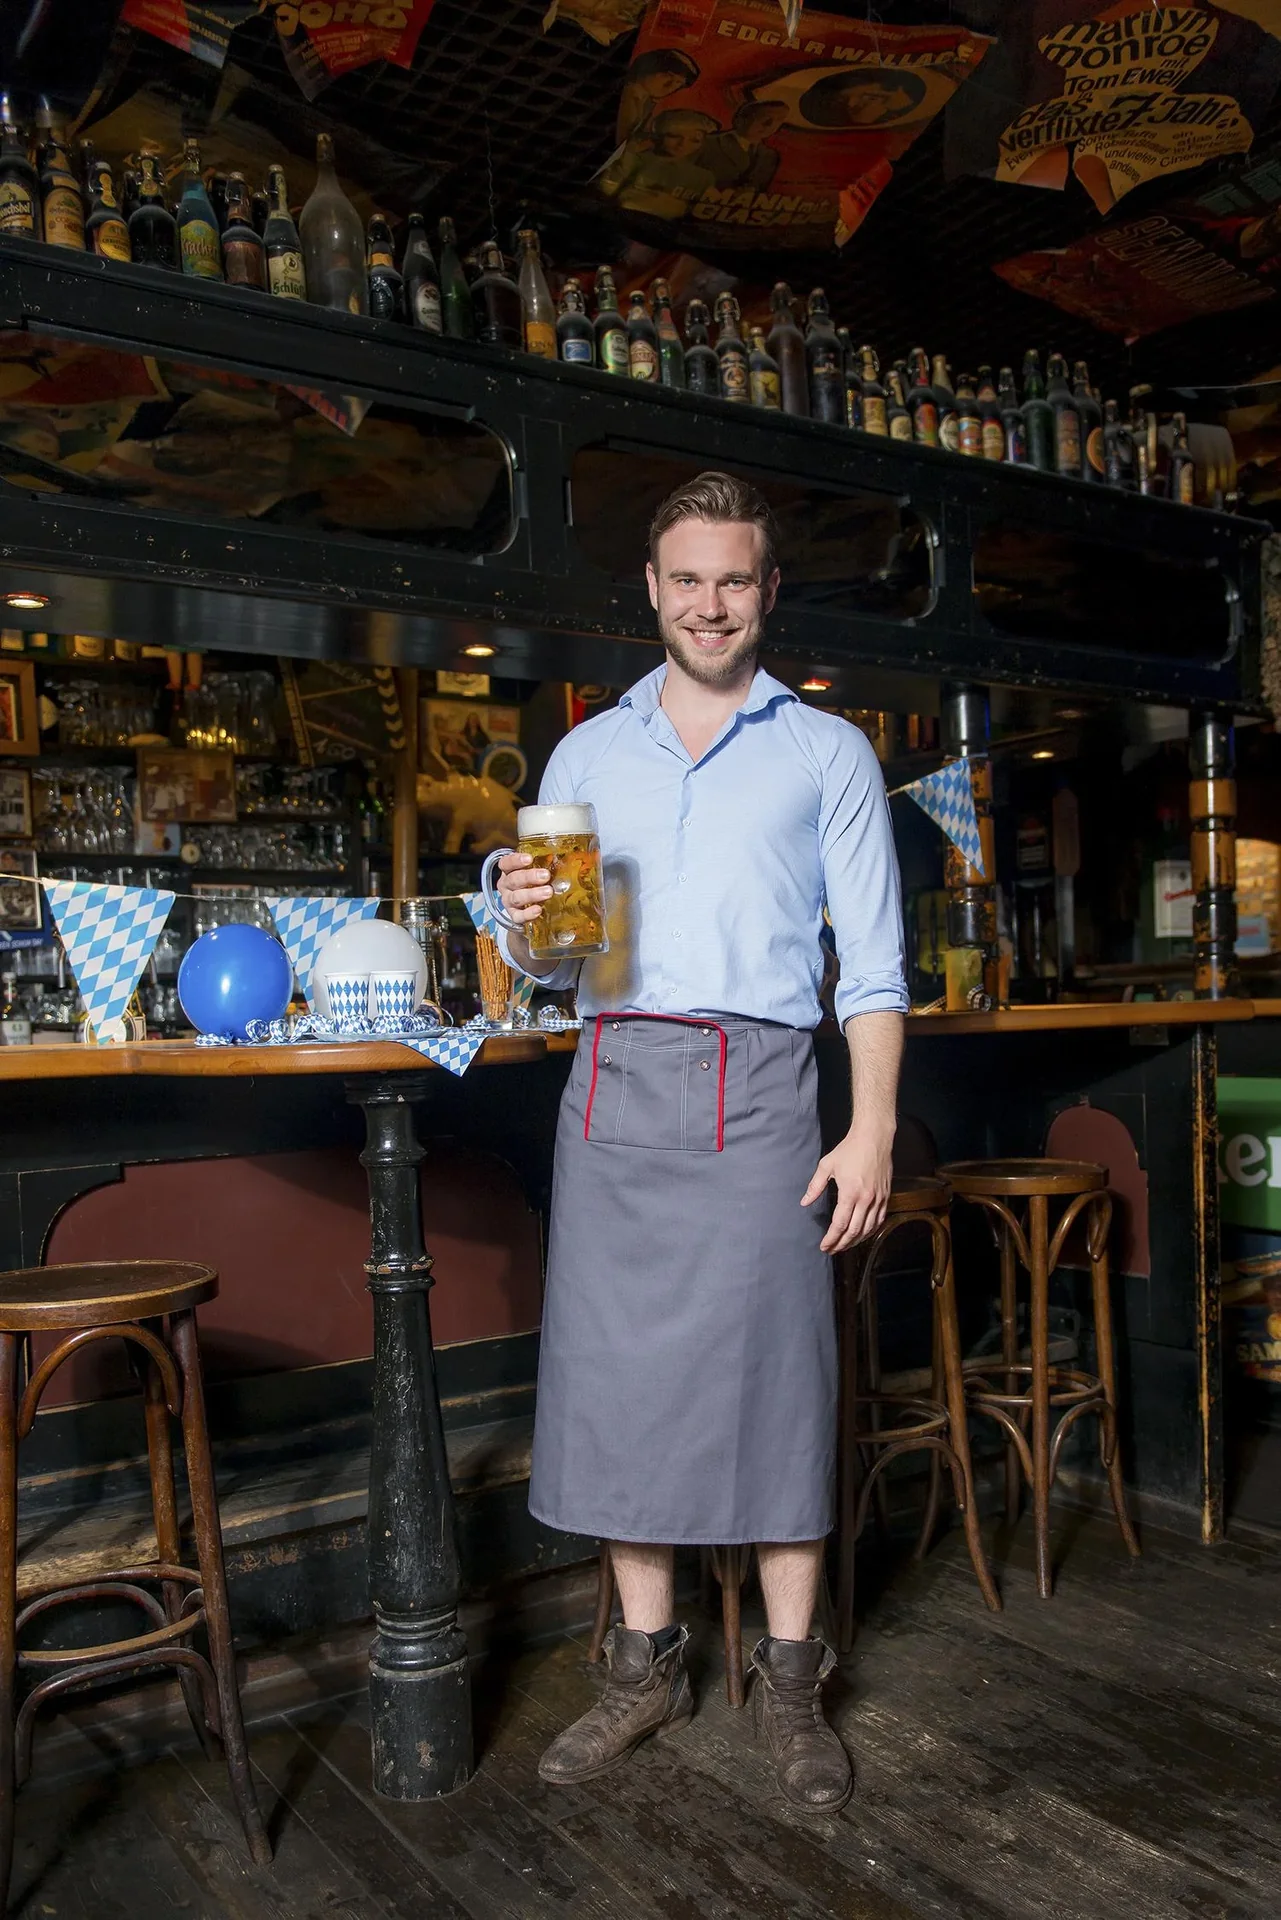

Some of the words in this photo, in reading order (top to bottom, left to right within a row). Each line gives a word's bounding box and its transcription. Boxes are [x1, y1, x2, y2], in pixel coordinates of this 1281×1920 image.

[1044, 8, 1211, 45] marilyn
[716, 19, 826, 55] EDGAR
[831, 38, 975, 66] WALLACE
[1044, 33, 1212, 69] monroe
[1160, 57, 1190, 68] mit
[1065, 74, 1119, 96] Tom
[1120, 66, 1189, 88] Ewell
[998, 109, 1122, 152] verflixte
[1109, 91, 1163, 129] 7
[1146, 96, 1239, 127] Jahr
[1011, 98, 1094, 130] das
[1104, 148, 1127, 159] und
[1127, 149, 1157, 166] vielen
[1109, 159, 1141, 184] anderen
[698, 185, 800, 213] MANN
